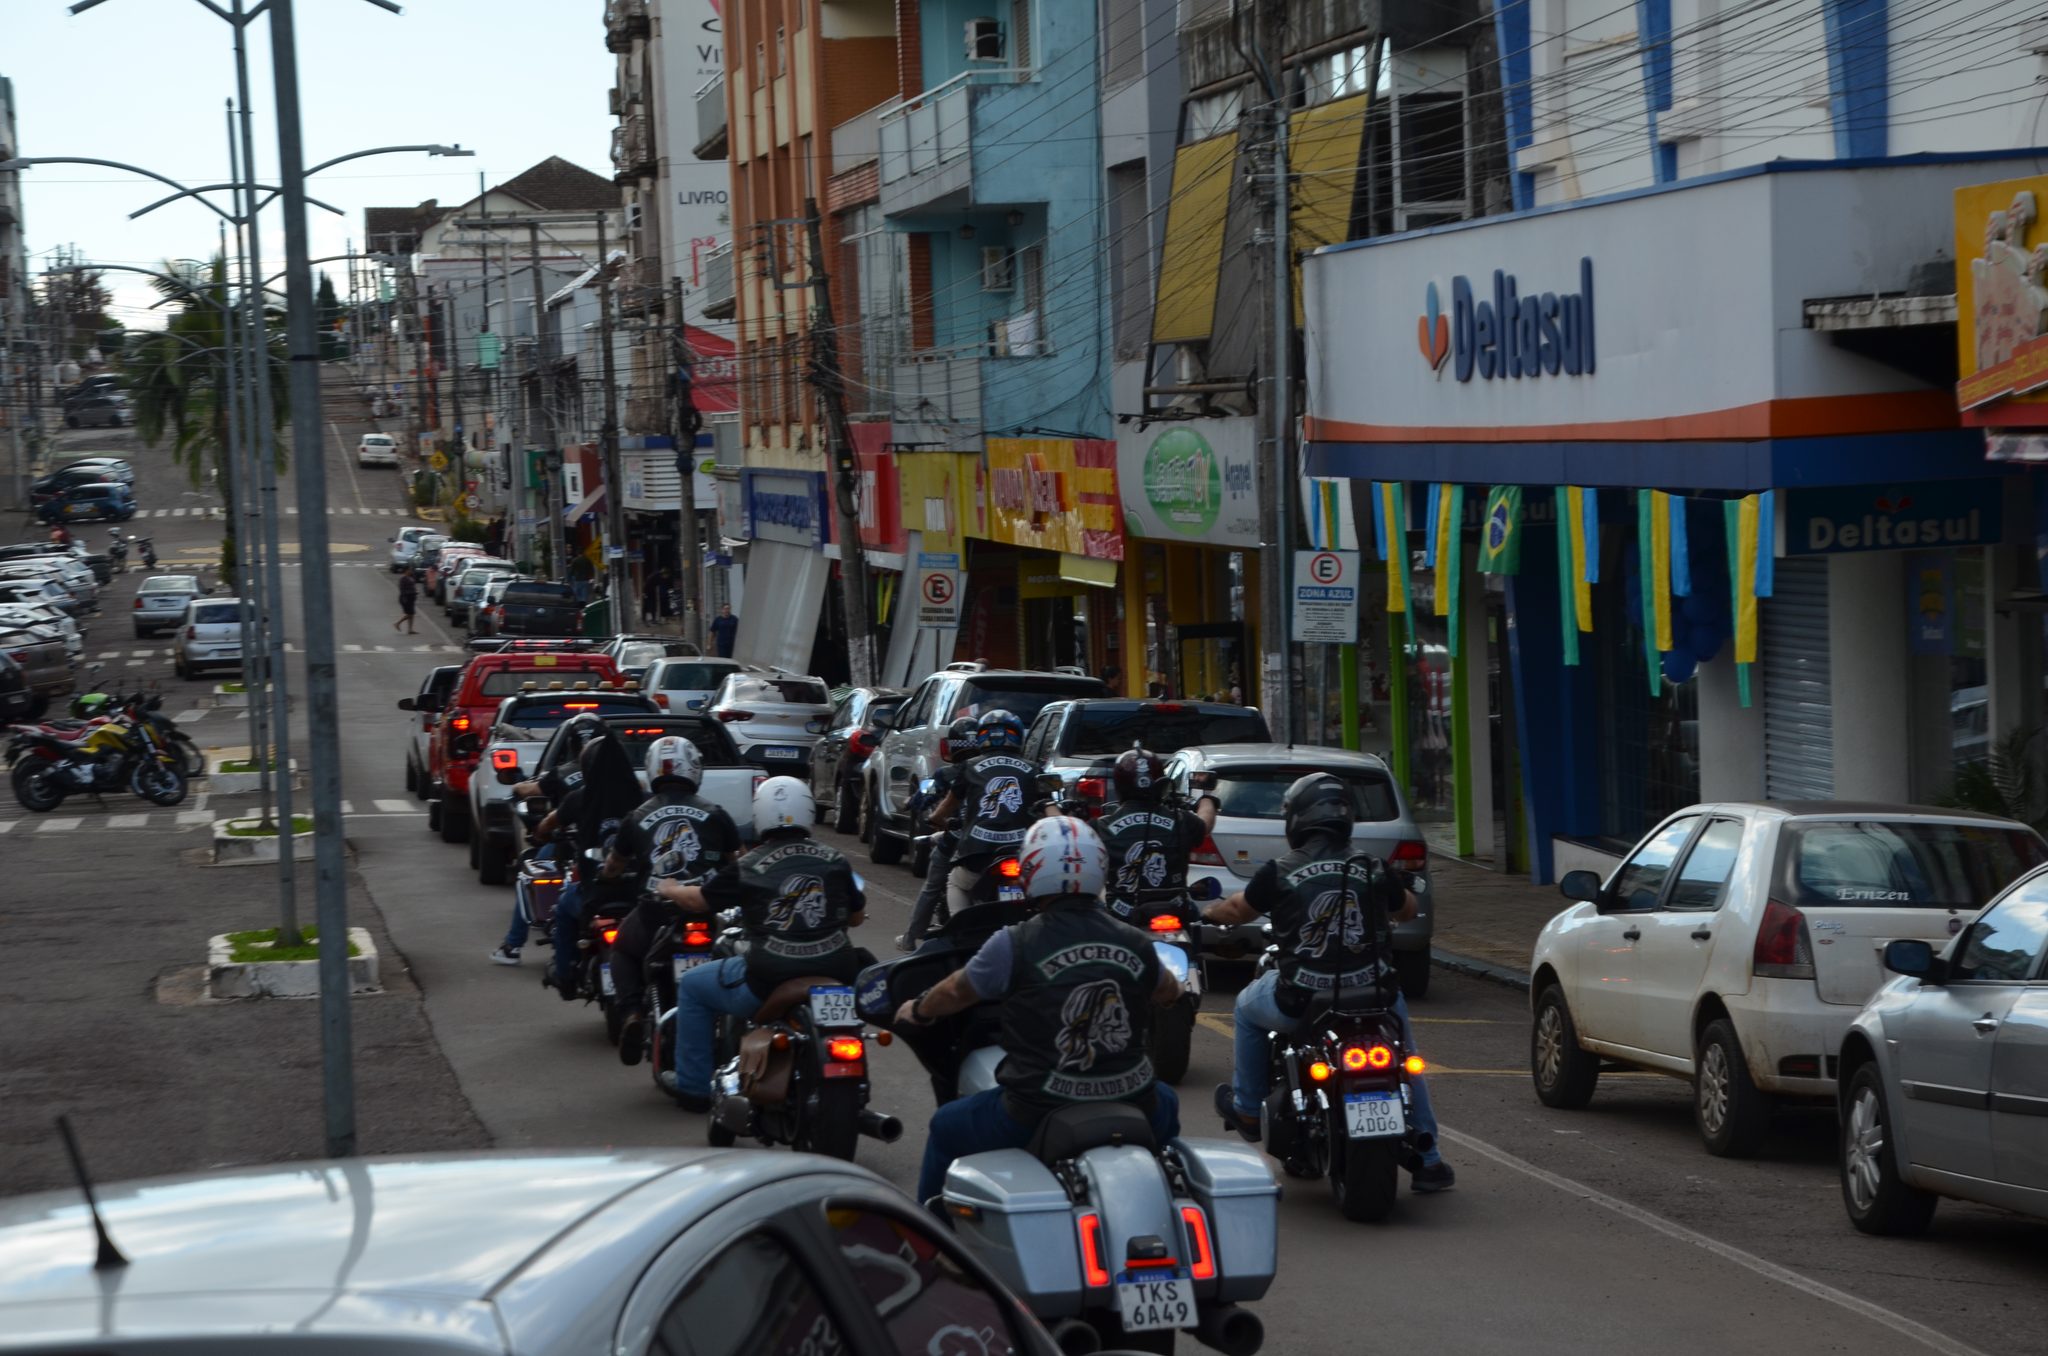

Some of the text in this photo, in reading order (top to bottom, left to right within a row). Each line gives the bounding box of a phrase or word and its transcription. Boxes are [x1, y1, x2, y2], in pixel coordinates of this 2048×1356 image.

[697, 45, 723, 63] VI
[1453, 256, 1596, 384] Deltasul
[1809, 508, 1980, 550] Deltasul
[1320, 560, 1332, 577] E
[1300, 589, 1353, 599] ZONA AZUL
[979, 757, 1030, 772] XUCROS
[645, 806, 705, 823] XUCROS
[1112, 814, 1172, 831] XUCROS
[759, 845, 830, 866] XUCROS
[1293, 862, 1369, 883] XUCROS
[1835, 887, 1912, 901] Ernzen
[1045, 946, 1141, 975] XUCROS
[1050, 1077, 1072, 1095] RIO
[1075, 1079, 1125, 1097] GRANDE
[1125, 1072, 1141, 1090] DO
[1135, 1281, 1179, 1304] TKS
[1133, 1301, 1189, 1326] 6A49
